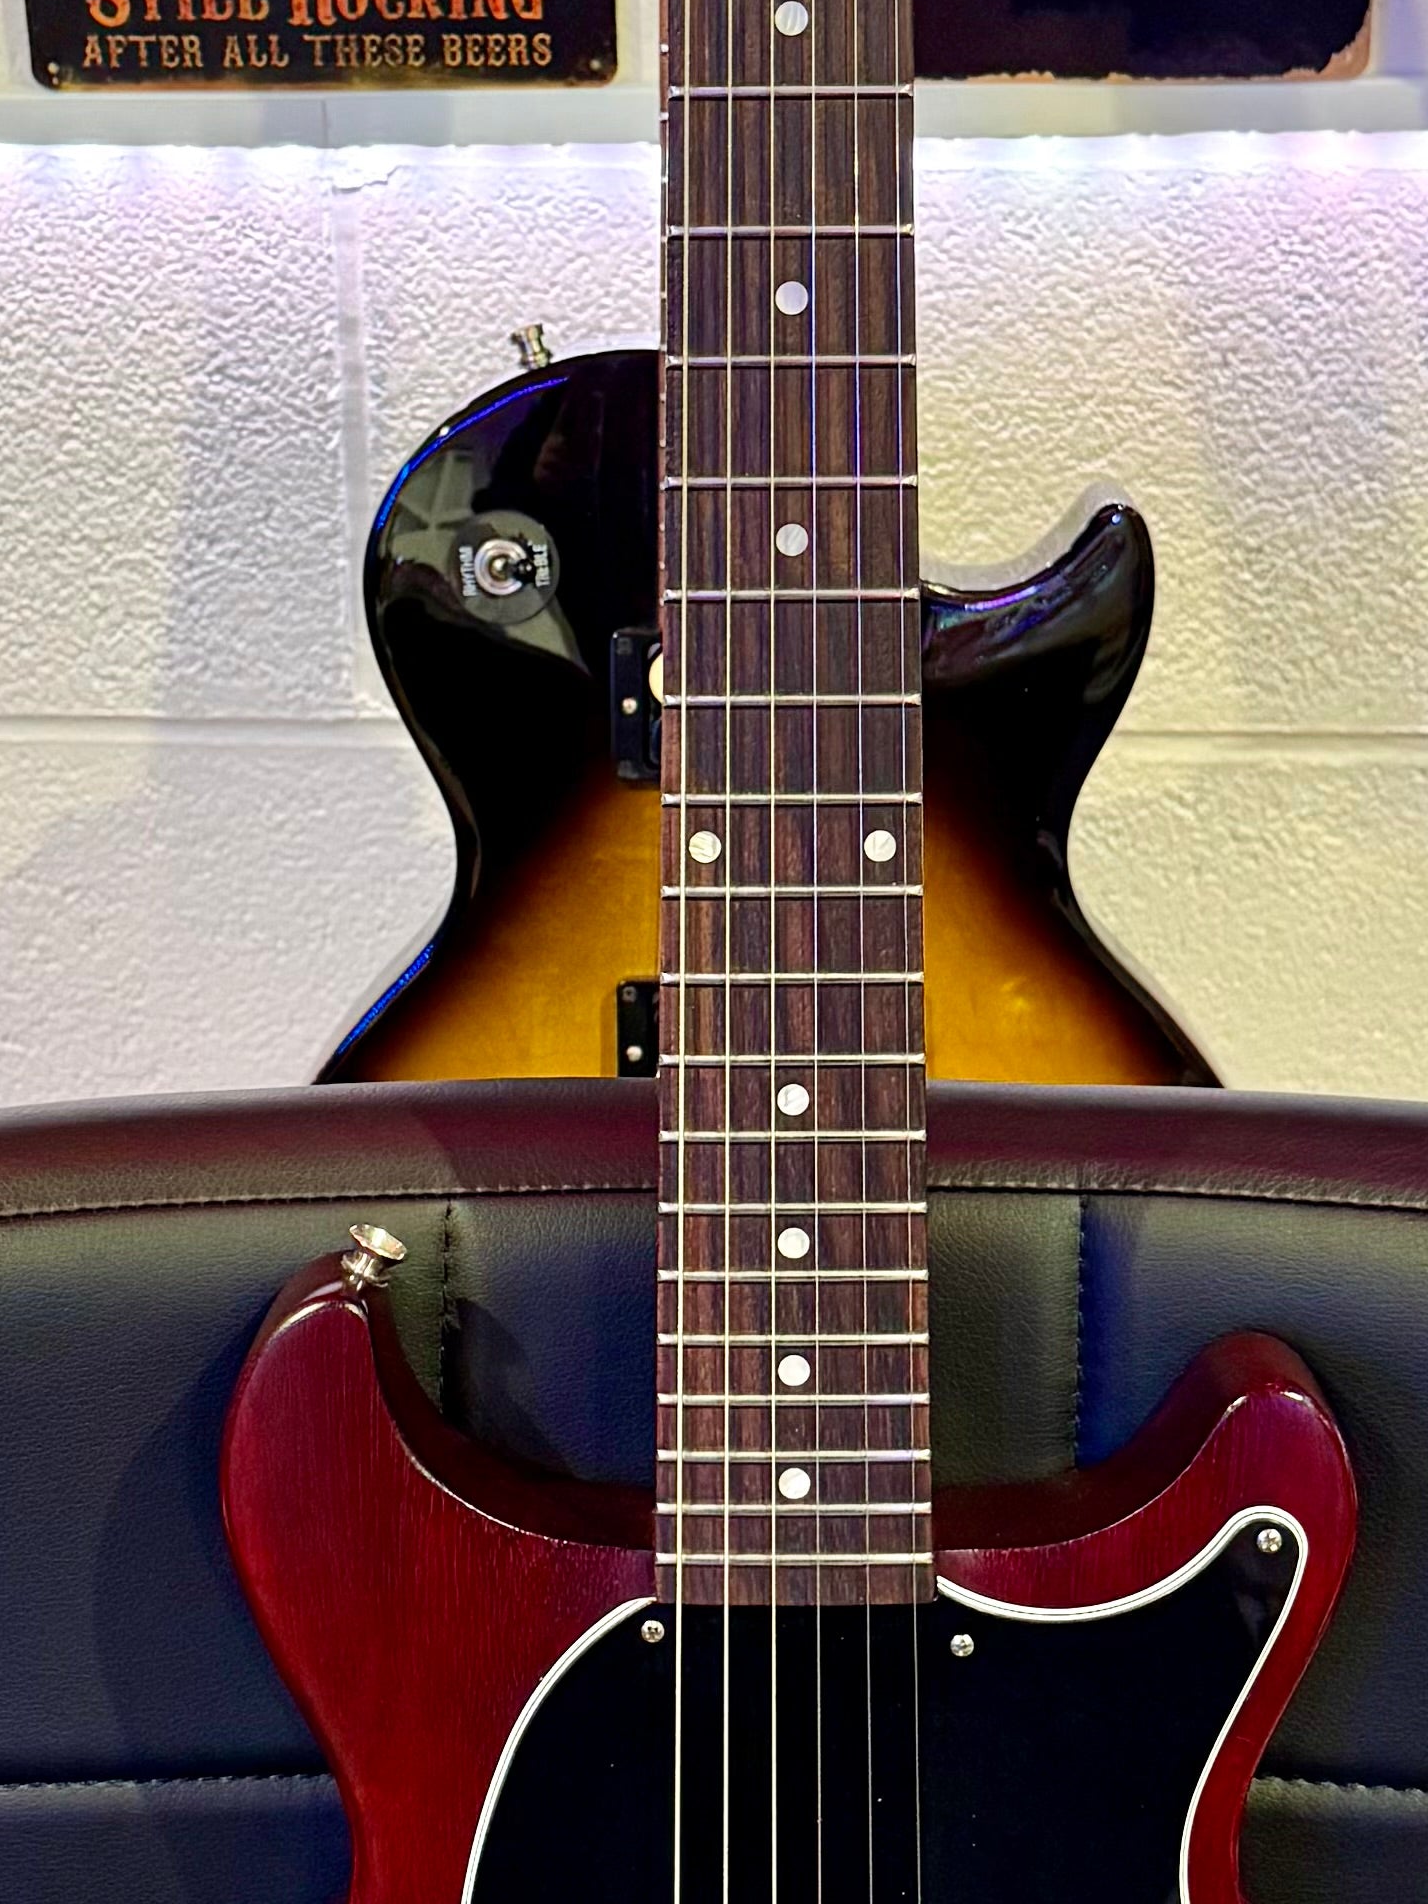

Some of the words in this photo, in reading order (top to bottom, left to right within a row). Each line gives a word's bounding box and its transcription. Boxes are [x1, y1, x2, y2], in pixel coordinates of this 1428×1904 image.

[82, 33, 203, 69] AFTER
[223, 33, 290, 68] ALL
[303, 33, 427, 67] THESE
[443, 33, 554, 68] BEERS
